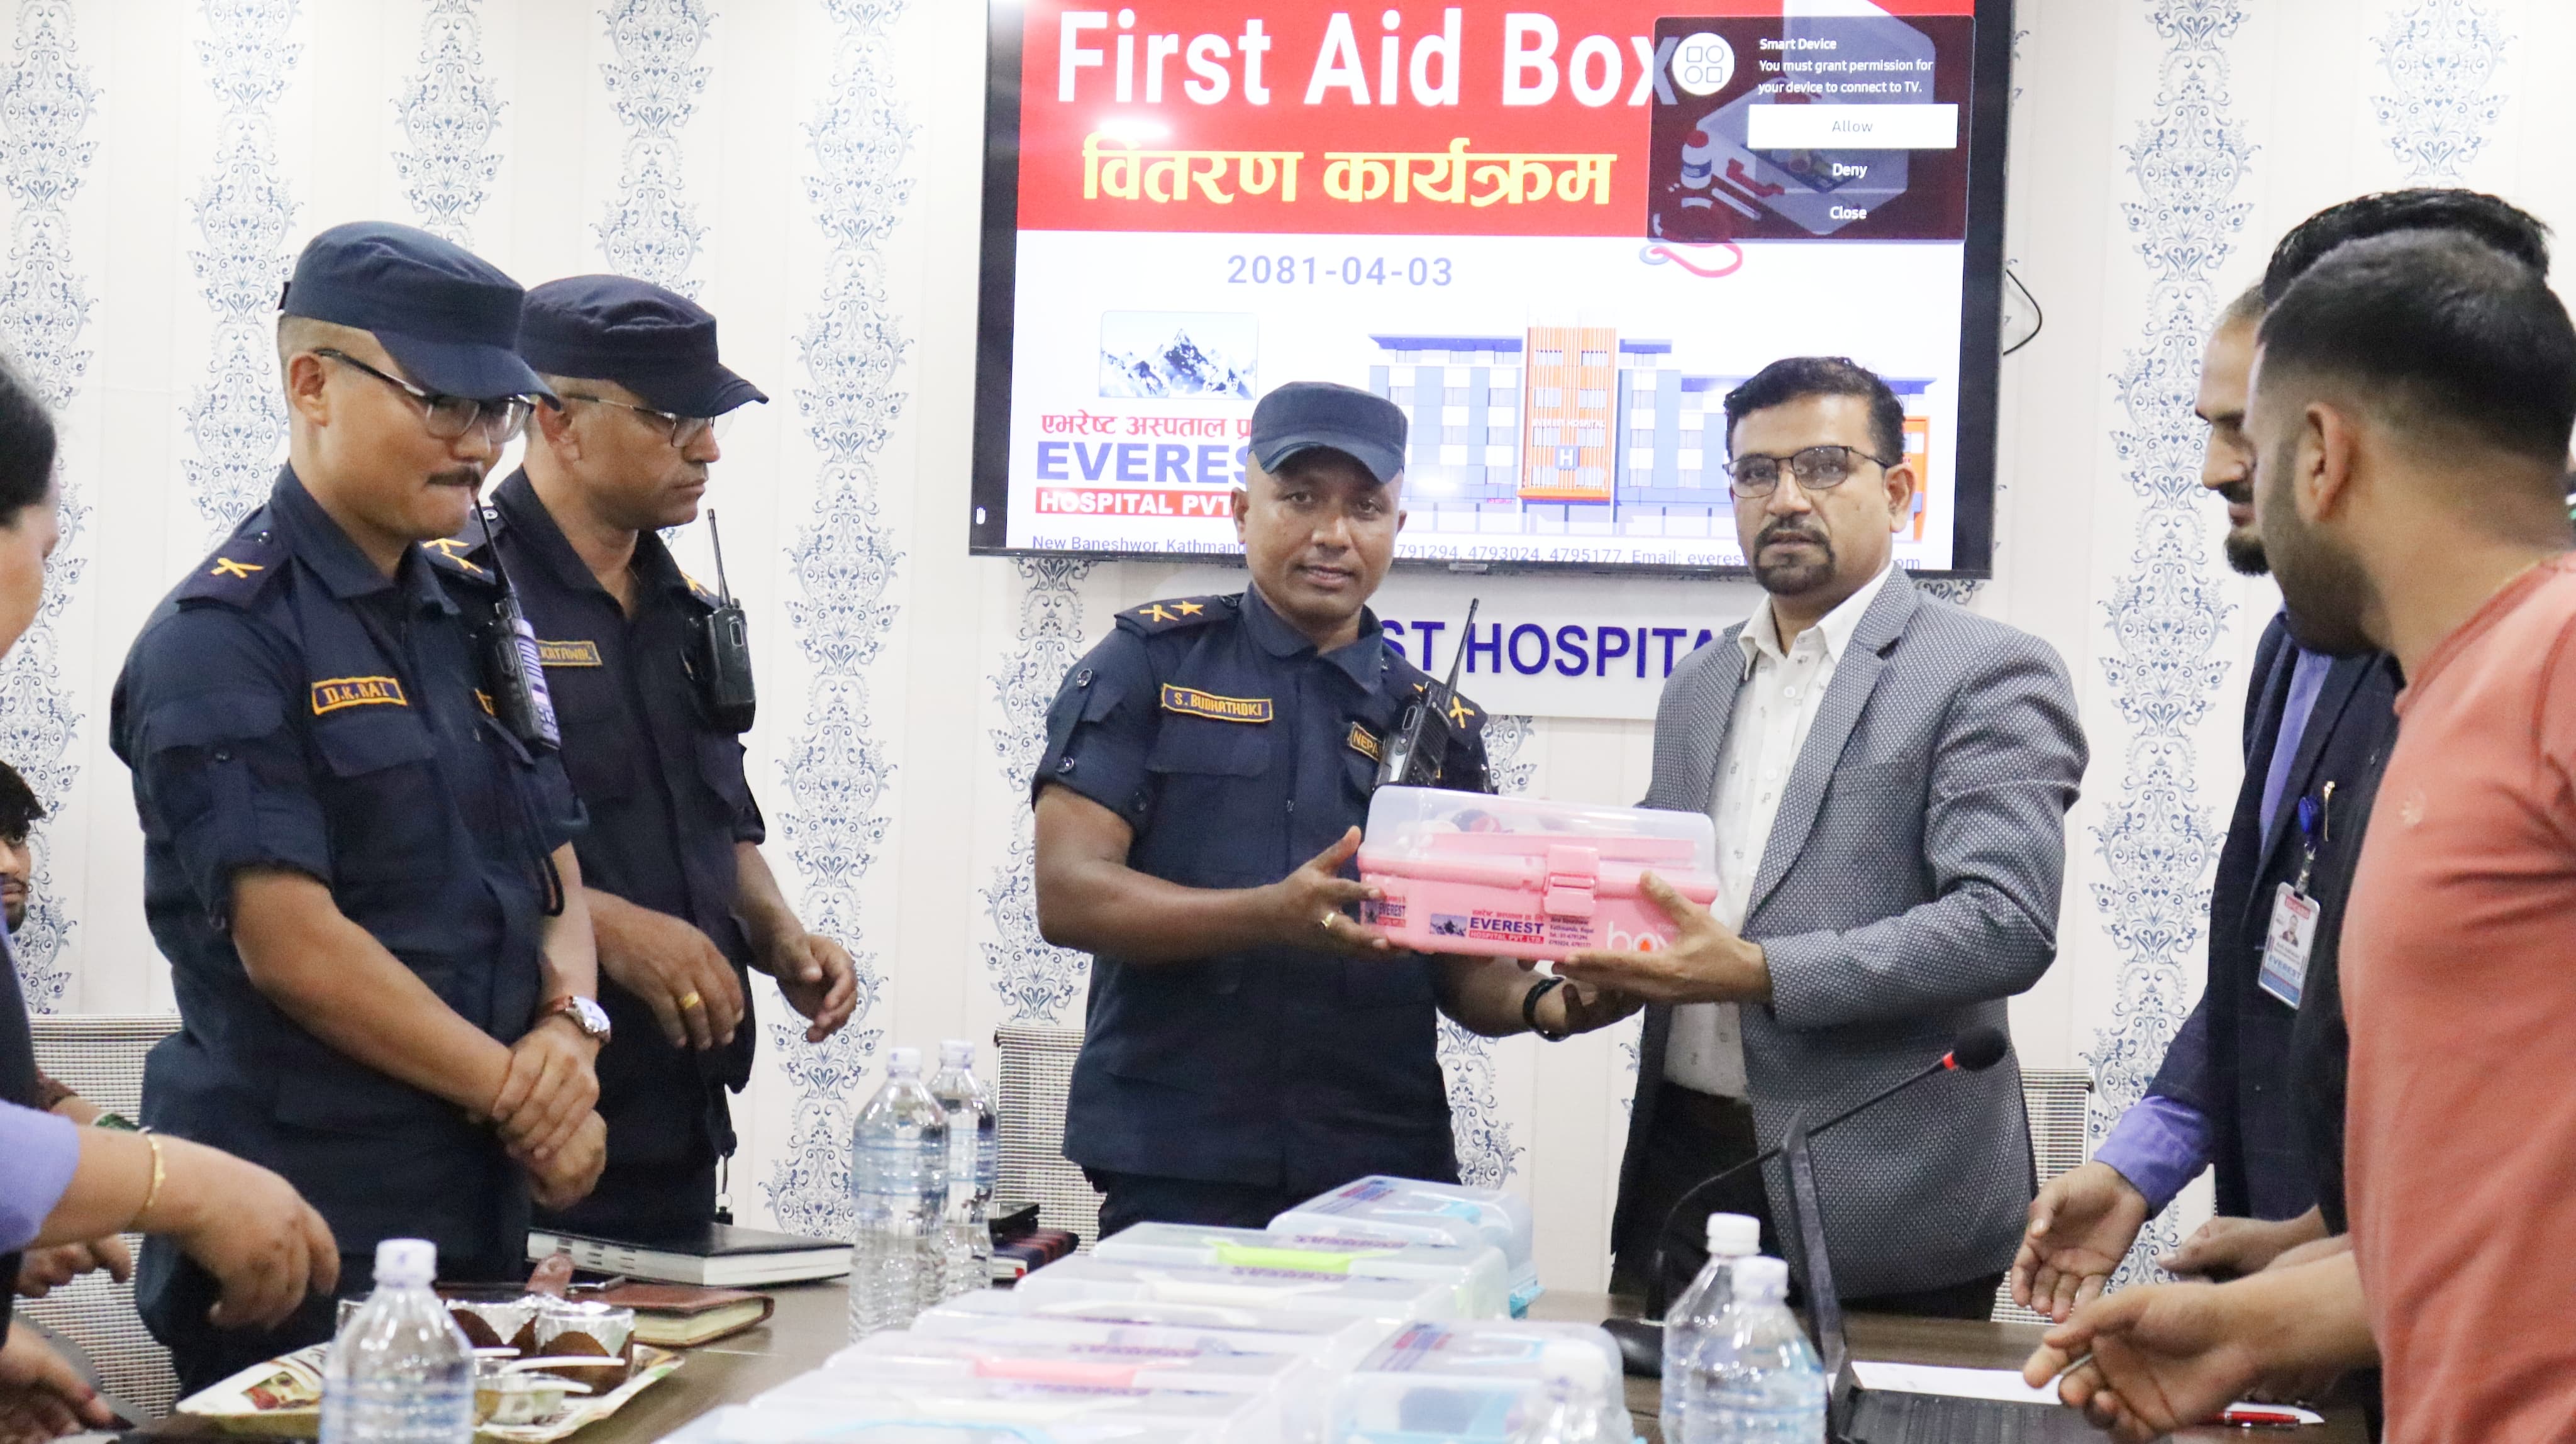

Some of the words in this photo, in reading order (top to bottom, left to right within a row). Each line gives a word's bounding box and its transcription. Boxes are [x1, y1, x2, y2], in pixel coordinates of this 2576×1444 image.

[1760, 38, 1796, 50] Smart
[1798, 38, 1836, 50] Device
[1058, 9, 1272, 104] First
[1304, 8, 1462, 106] Aid
[1504, 13, 1678, 108] Box
[1760, 60, 1780, 71] You
[1783, 60, 1812, 71] must
[1816, 61, 1848, 74] grant
[1849, 60, 1915, 74] permission
[1917, 59, 1933, 70] for
[1758, 83, 1784, 95] your
[1787, 82, 1823, 93] device
[1826, 82, 1838, 93] to
[1841, 82, 1887, 93] connect
[1889, 82, 1902, 92] to
[1904, 81, 1923, 93] TV.
[1831, 120, 1874, 133] Allow
[1082, 130, 1304, 204] वितरण
[1323, 137, 1618, 208] कार्यक्रम
[1832, 164, 1868, 179] Deny
[1829, 206, 1867, 219] Close
[1227, 254, 1453, 287] 2081-04-03
[1126, 416, 1228, 438] अस्पताल
[1559, 448, 1574, 467] H
[1040, 491, 1174, 514] HOSPITAL
[1033, 536, 1066, 550] New
[1167, 538, 1245, 554] Kathmand
[1632, 549, 1681, 565] Email:
[1380, 619, 1445, 672] ST
[1470, 916, 1545, 935] EVEREST
[1470, 931, 1506, 941] HOSPITAL
